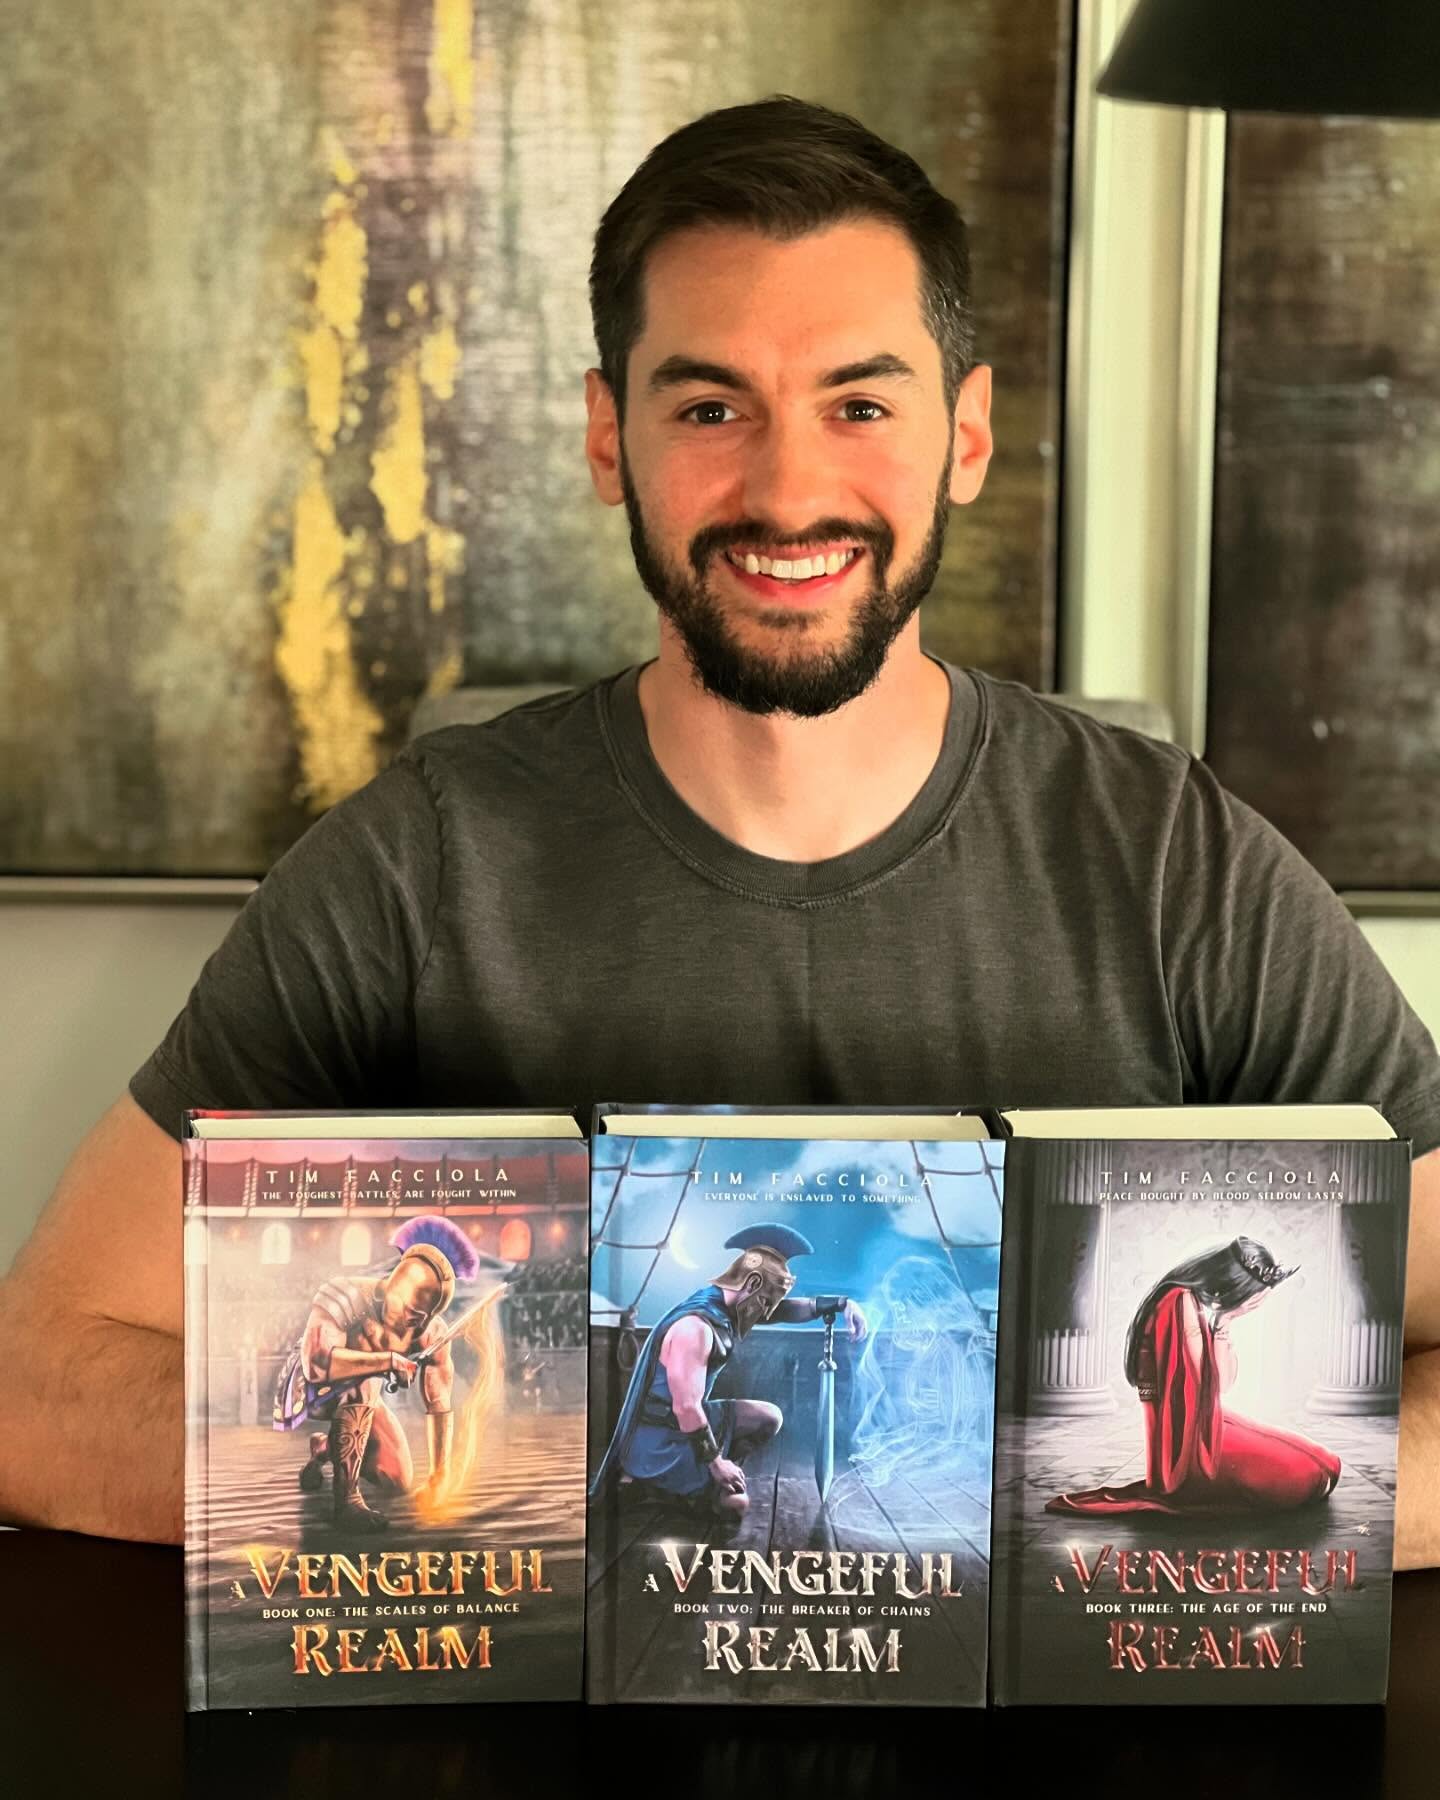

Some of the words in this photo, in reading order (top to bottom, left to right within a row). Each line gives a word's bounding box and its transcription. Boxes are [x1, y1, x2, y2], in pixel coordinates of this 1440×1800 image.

[265, 1170, 318, 1184] TIM
[347, 1168, 509, 1183] FACCIOLA
[690, 1171, 742, 1185] TIM
[772, 1172, 933, 1187] FACCIOLA
[1100, 1171, 1152, 1185] TIM
[1180, 1171, 1341, 1185] FACCIOLA
[262, 1191, 281, 1200] THE
[288, 1191, 342, 1200] TOUGHEST
[349, 1190, 400, 1199] BATTLES
[404, 1190, 425, 1199] ARE
[431, 1189, 471, 1199] FOUGHT
[479, 1189, 516, 1198] WITHIN
[705, 1192, 758, 1201] EVERYONE
[764, 1193, 775, 1202] IS
[780, 1193, 833, 1202] ENSLAVED
[841, 1193, 857, 1203] TO
[863, 1194, 922, 1204] SOMETHING
[1099, 1191, 1134, 1201] PEACE
[1140, 1191, 1185, 1200] BOUGHT
[1192, 1191, 1207, 1200] BY
[1213, 1191, 1250, 1200] BLOOD
[1258, 1191, 1301, 1200] SELDOM
[1307, 1190, 1344, 1200] LASTS
[230, 1581, 247, 1600] A
[244, 1546, 553, 1600] VENGEFUL
[642, 1573, 660, 1593] A
[659, 1543, 963, 1600] VENGEFUL
[1066, 1543, 1365, 1596] VENGEFUL
[263, 1608, 299, 1619] BOOK
[306, 1607, 336, 1618] ONE:
[343, 1606, 369, 1617] THE
[375, 1605, 426, 1616] SCALES
[433, 1604, 450, 1615] OF
[457, 1603, 520, 1614] BALANCE
[674, 1603, 709, 1614] BOOK
[716, 1604, 753, 1615] TWO:
[762, 1604, 786, 1615] THE
[792, 1605, 850, 1616] BREAKER
[858, 1605, 875, 1616] OF
[881, 1606, 931, 1617] CHAINS
[1086, 1603, 1122, 1614] BOOK
[1129, 1603, 1174, 1614] THREE:
[1181, 1603, 1206, 1614] THE
[1212, 1603, 1240, 1614] AGE
[1246, 1603, 1264, 1614] OF
[1270, 1603, 1295, 1614] THE
[1301, 1603, 1327, 1614] END
[290, 1623, 494, 1677] REALM
[702, 1620, 903, 1674] REALM
[1107, 1619, 1306, 1673] REALM
